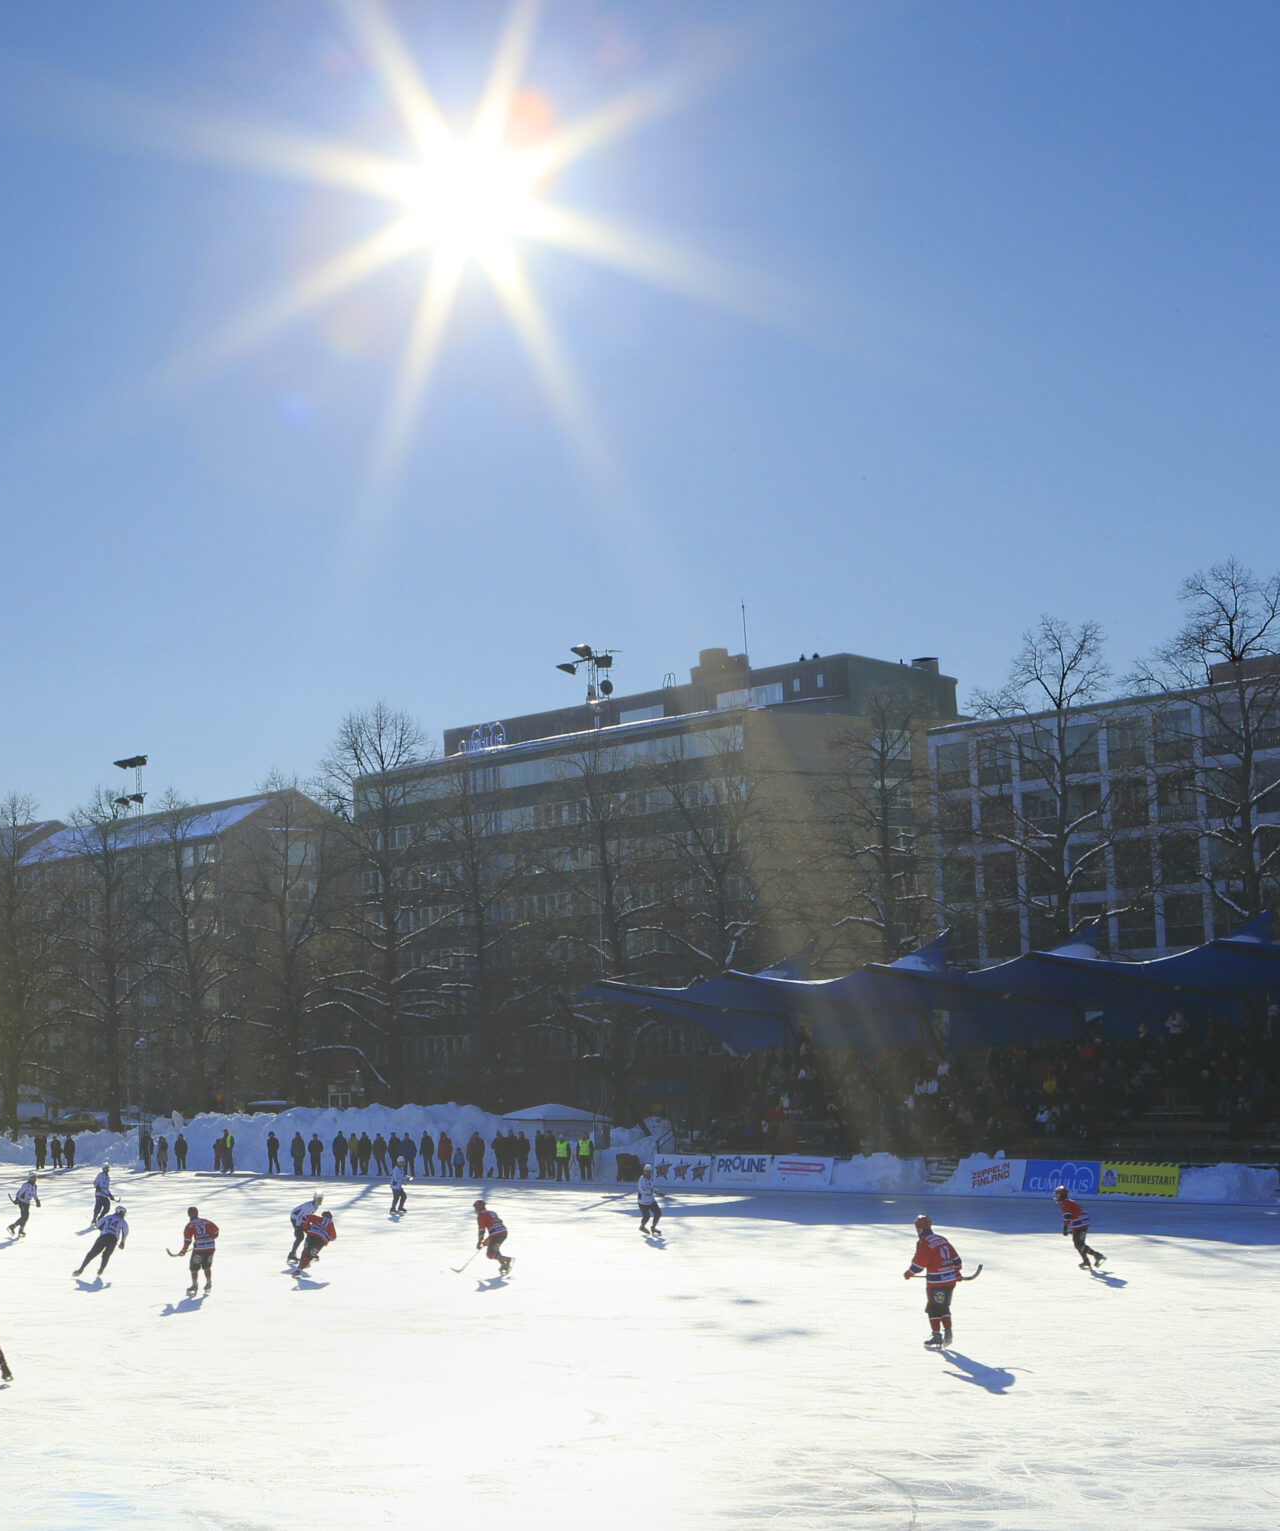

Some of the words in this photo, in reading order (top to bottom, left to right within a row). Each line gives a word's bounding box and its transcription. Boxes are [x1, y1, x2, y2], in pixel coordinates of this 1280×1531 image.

[717, 1156, 767, 1173] PROLINE
[972, 1161, 1010, 1180] ZEPPELIN
[972, 1170, 1010, 1189] FINLAND
[1117, 1174, 1177, 1186] TULITEMESTARIT
